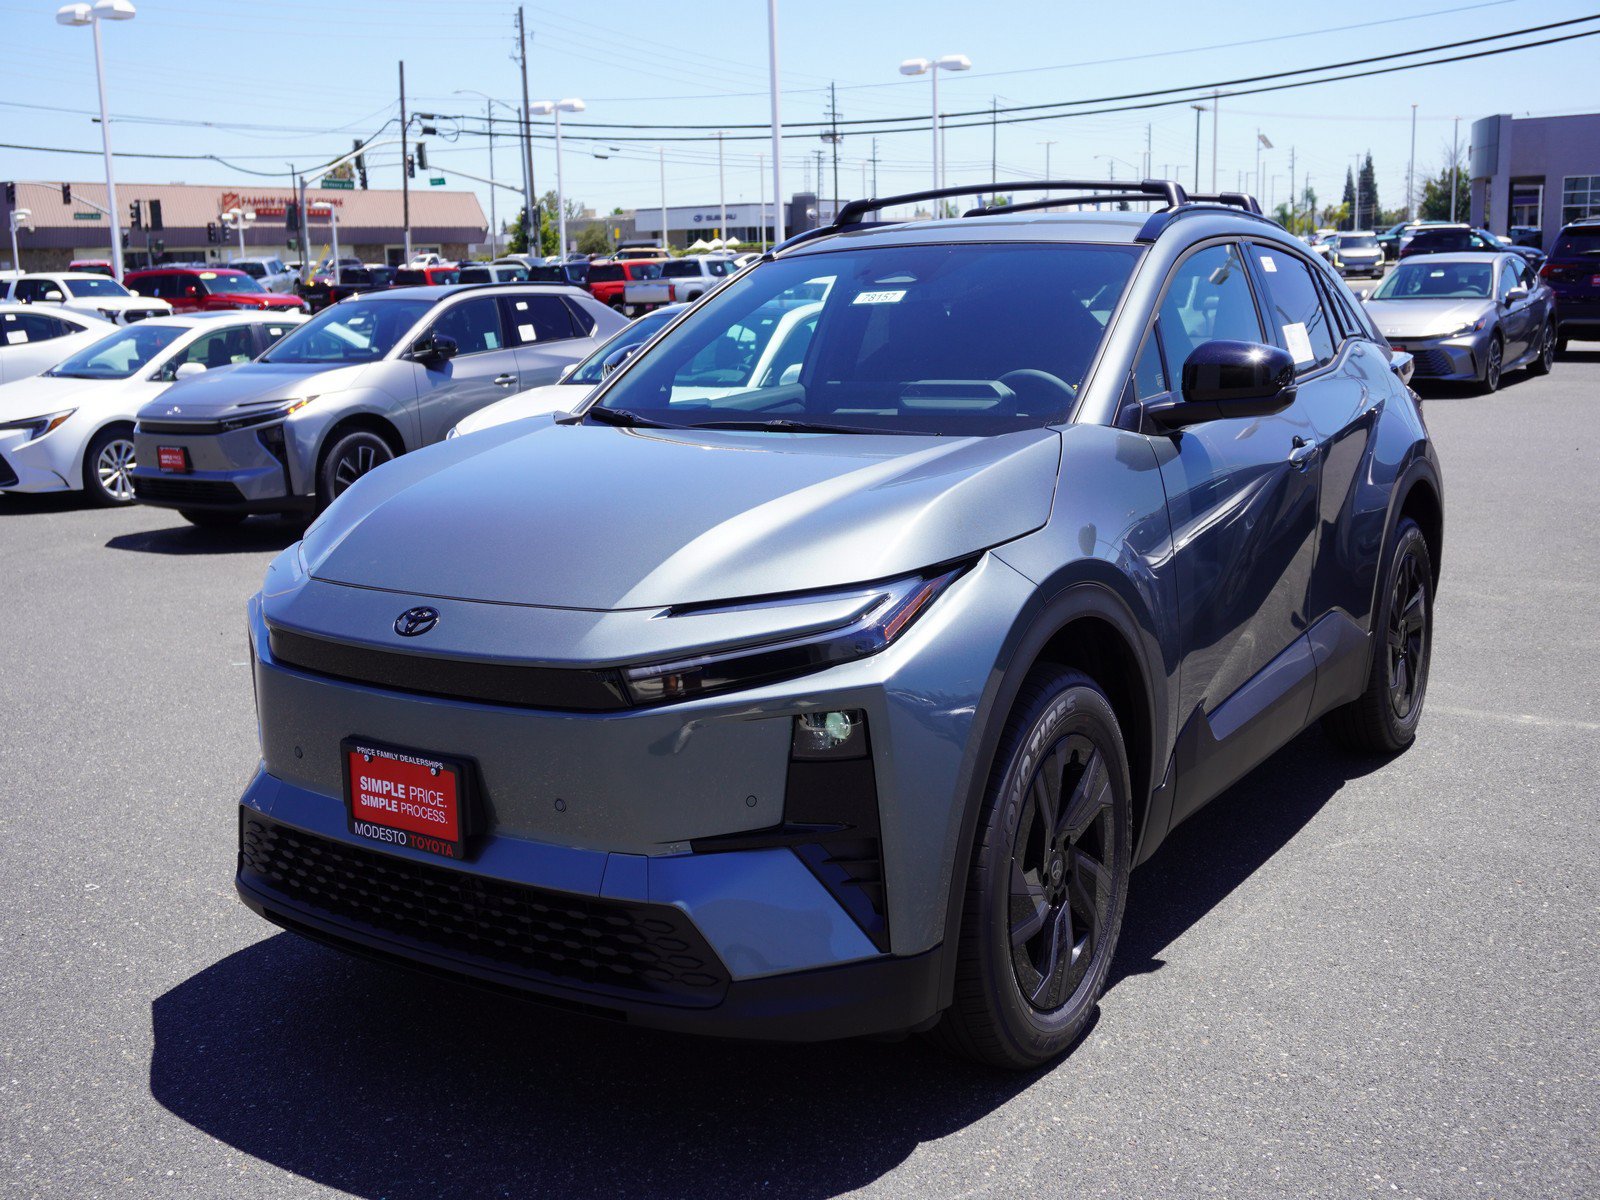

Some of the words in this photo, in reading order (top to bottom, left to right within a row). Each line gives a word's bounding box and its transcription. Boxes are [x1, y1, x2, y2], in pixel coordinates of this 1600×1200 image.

[241, 196, 275, 206] FAMILY
[862, 292, 897, 302] 78157
[1030, 694, 1076, 753] TIRES
[356, 746, 376, 756] PRICE
[376, 750, 399, 761] FAMILY
[399, 754, 444, 770] DEALERSHIPS
[360, 775, 406, 799] SIMPLE
[409, 786, 448, 808] PRICE.
[360, 793, 399, 812] SIMPLE
[401, 803, 448, 824] PROCESS.
[354, 822, 407, 845] MODESTO
[410, 834, 454, 857] TOYOTA
